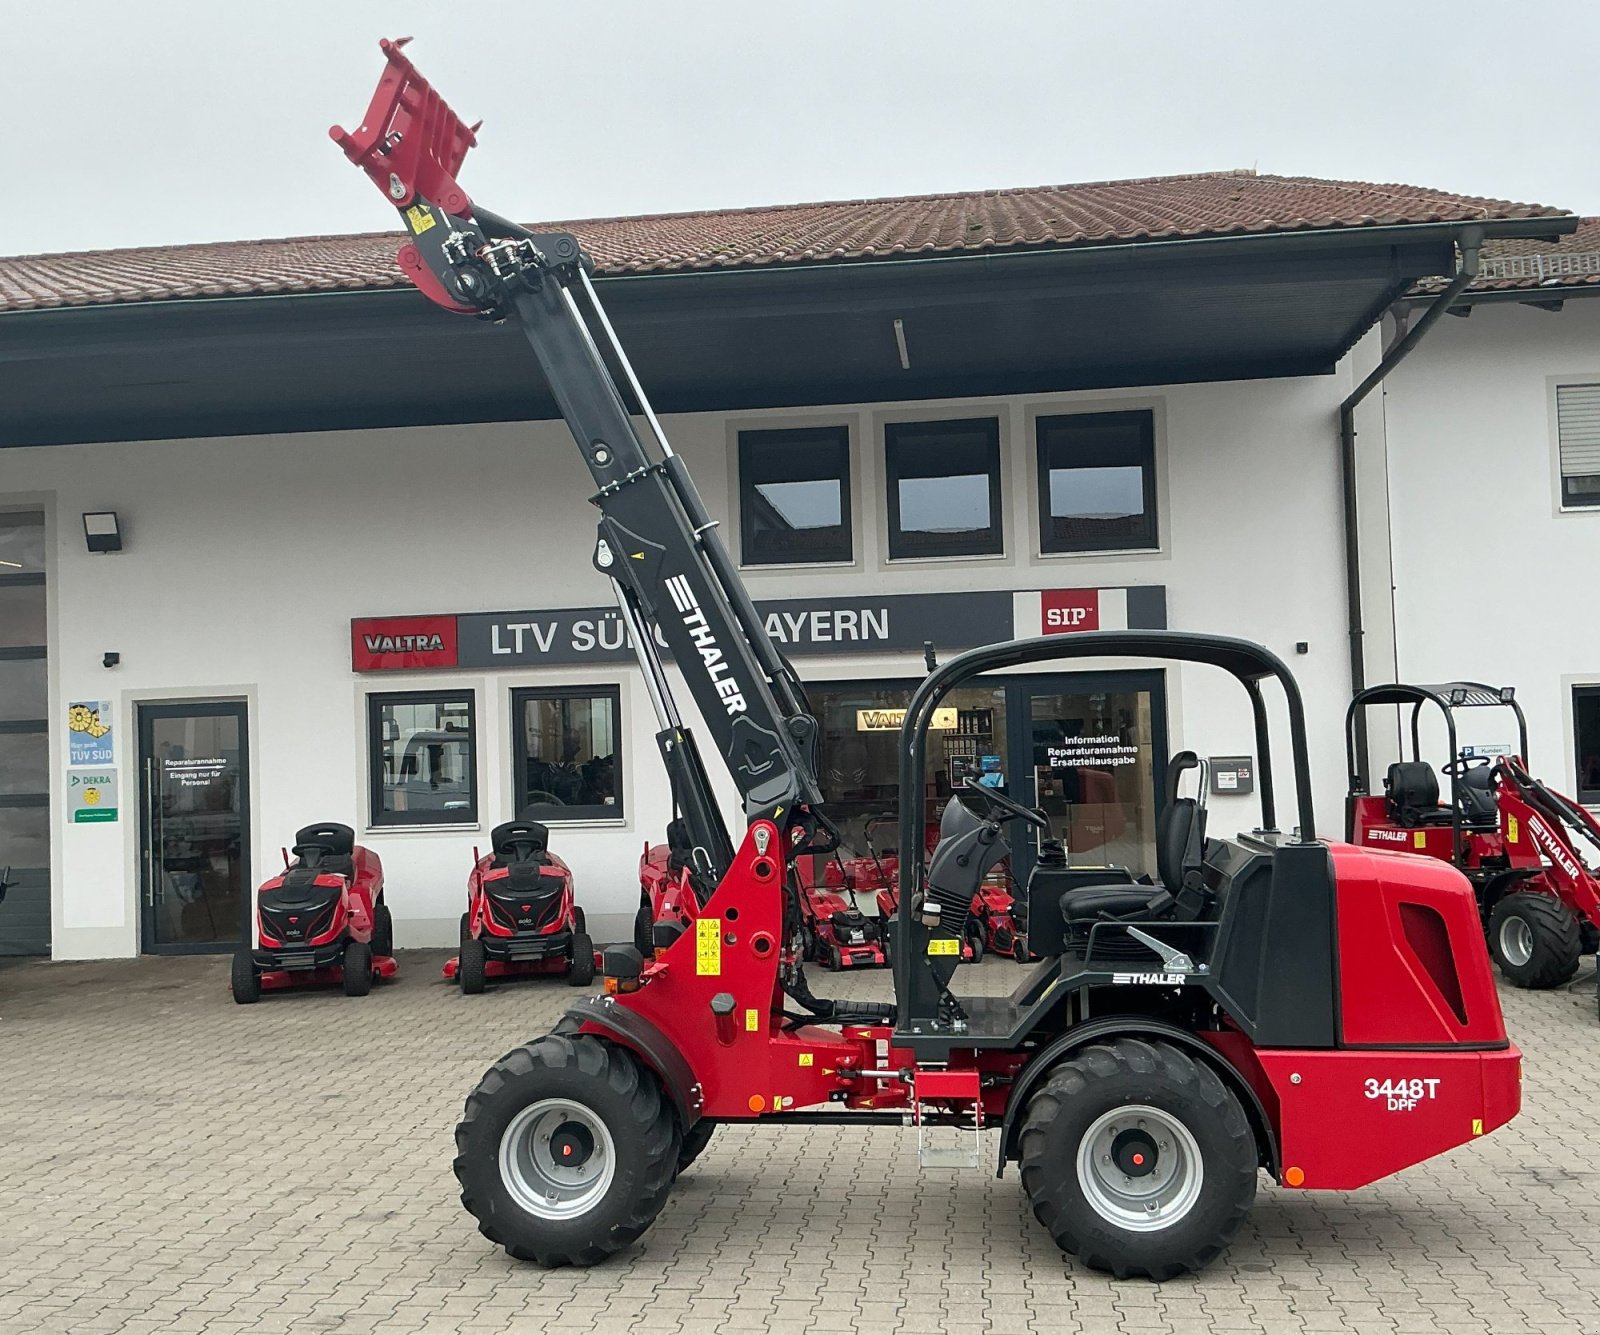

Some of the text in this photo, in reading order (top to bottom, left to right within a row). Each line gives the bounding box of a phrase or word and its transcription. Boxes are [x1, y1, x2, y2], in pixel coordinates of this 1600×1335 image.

[363, 633, 446, 655] VALTRA
[491, 622, 558, 656] LTV
[861, 710, 934, 729] VALT
[1064, 735, 1120, 745] Information
[71, 748, 113, 761] TÜV SÜD
[1047, 745, 1139, 757] Reparaturannahme
[165, 758, 227, 767] Reparaturannahme
[1050, 756, 1136, 767] Ersatzteilausgabe
[83, 775, 111, 785] DEKRA
[170, 772, 198, 780] Eingang
[211, 770, 221, 778] für
[1364, 1078, 1441, 1099] 3448T
[1387, 1099, 1418, 1112] DPF
